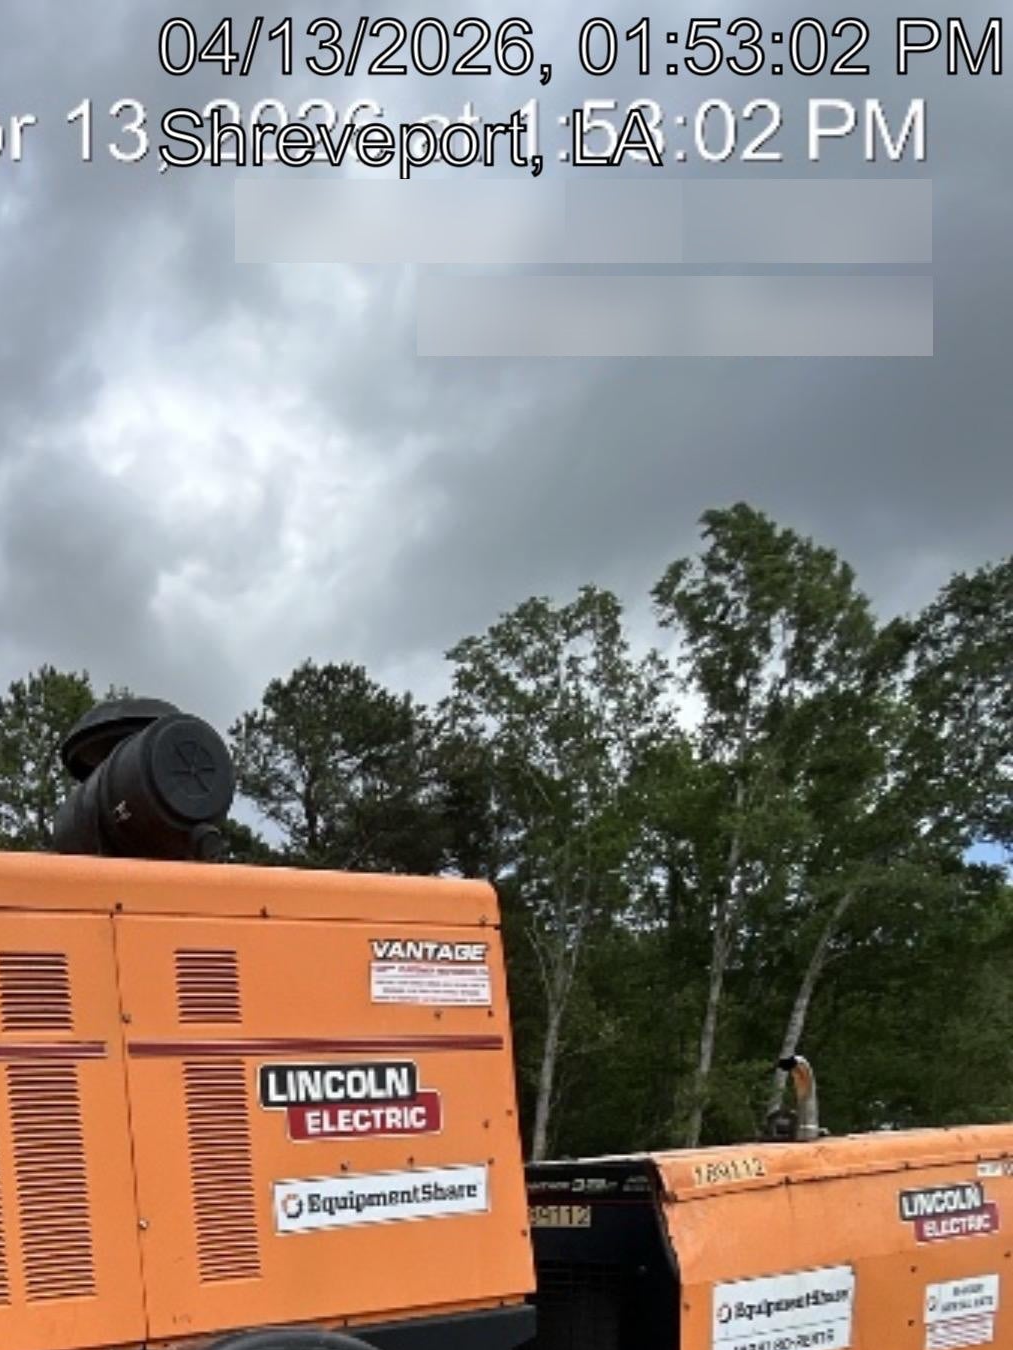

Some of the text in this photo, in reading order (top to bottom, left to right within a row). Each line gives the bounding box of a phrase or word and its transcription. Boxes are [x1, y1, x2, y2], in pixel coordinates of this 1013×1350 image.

[371, 940, 487, 962] VANTAGE
[267, 1068, 410, 1102] LINCOLN
[305, 1106, 426, 1136] ELECTRIC
[307, 1180, 478, 1216] EquipmentShare
[902, 1186, 982, 1218] LINCOLN
[923, 1213, 991, 1238] ELECTRIC
